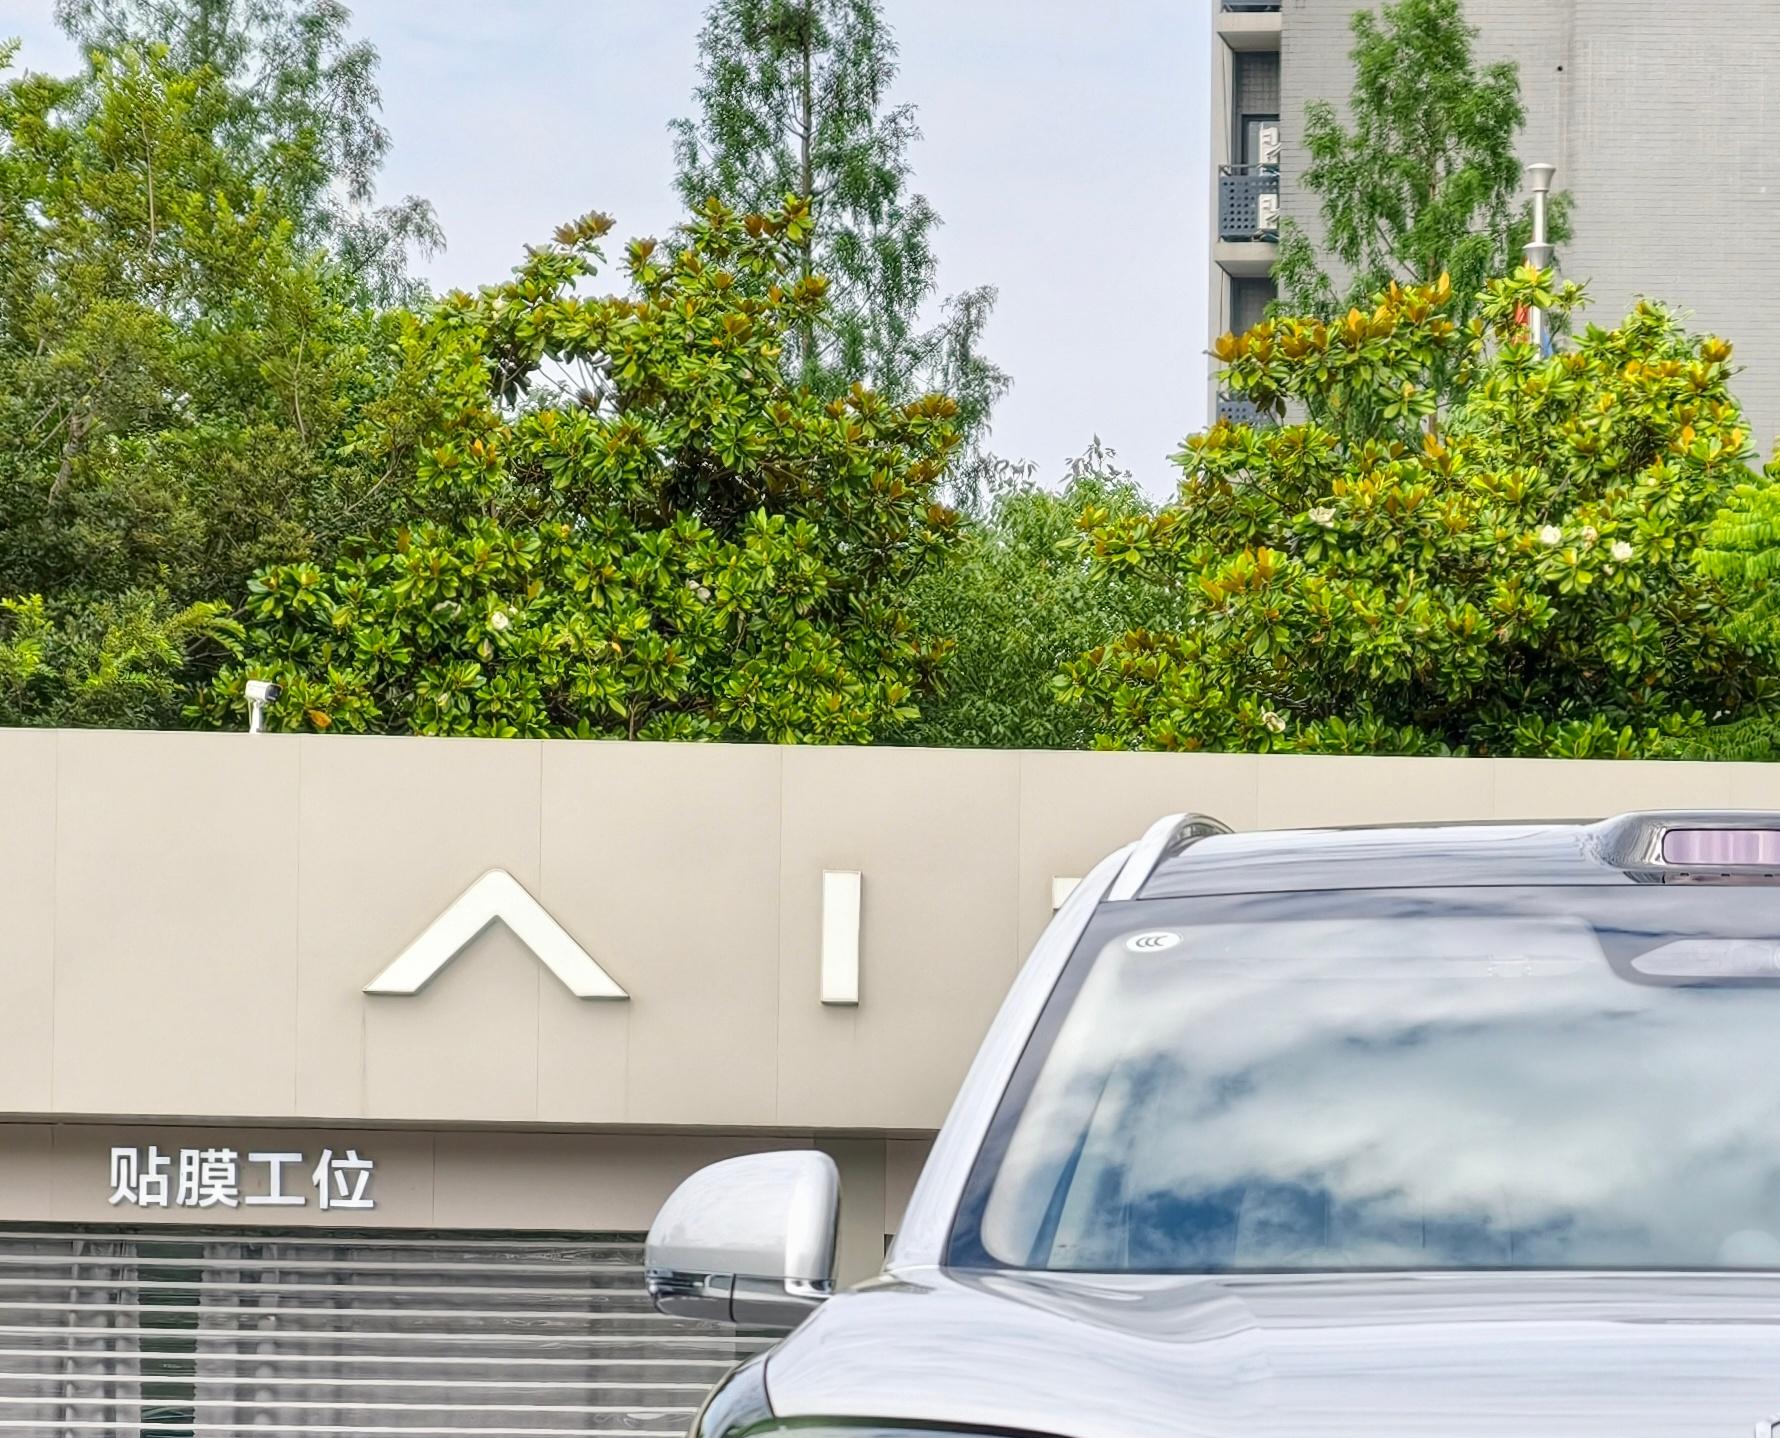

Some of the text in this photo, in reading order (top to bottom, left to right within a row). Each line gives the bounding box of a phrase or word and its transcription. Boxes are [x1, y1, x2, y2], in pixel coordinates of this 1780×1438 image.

[363, 868, 1081, 1006] AI
[108, 1145, 374, 1210] 贴膜工位
